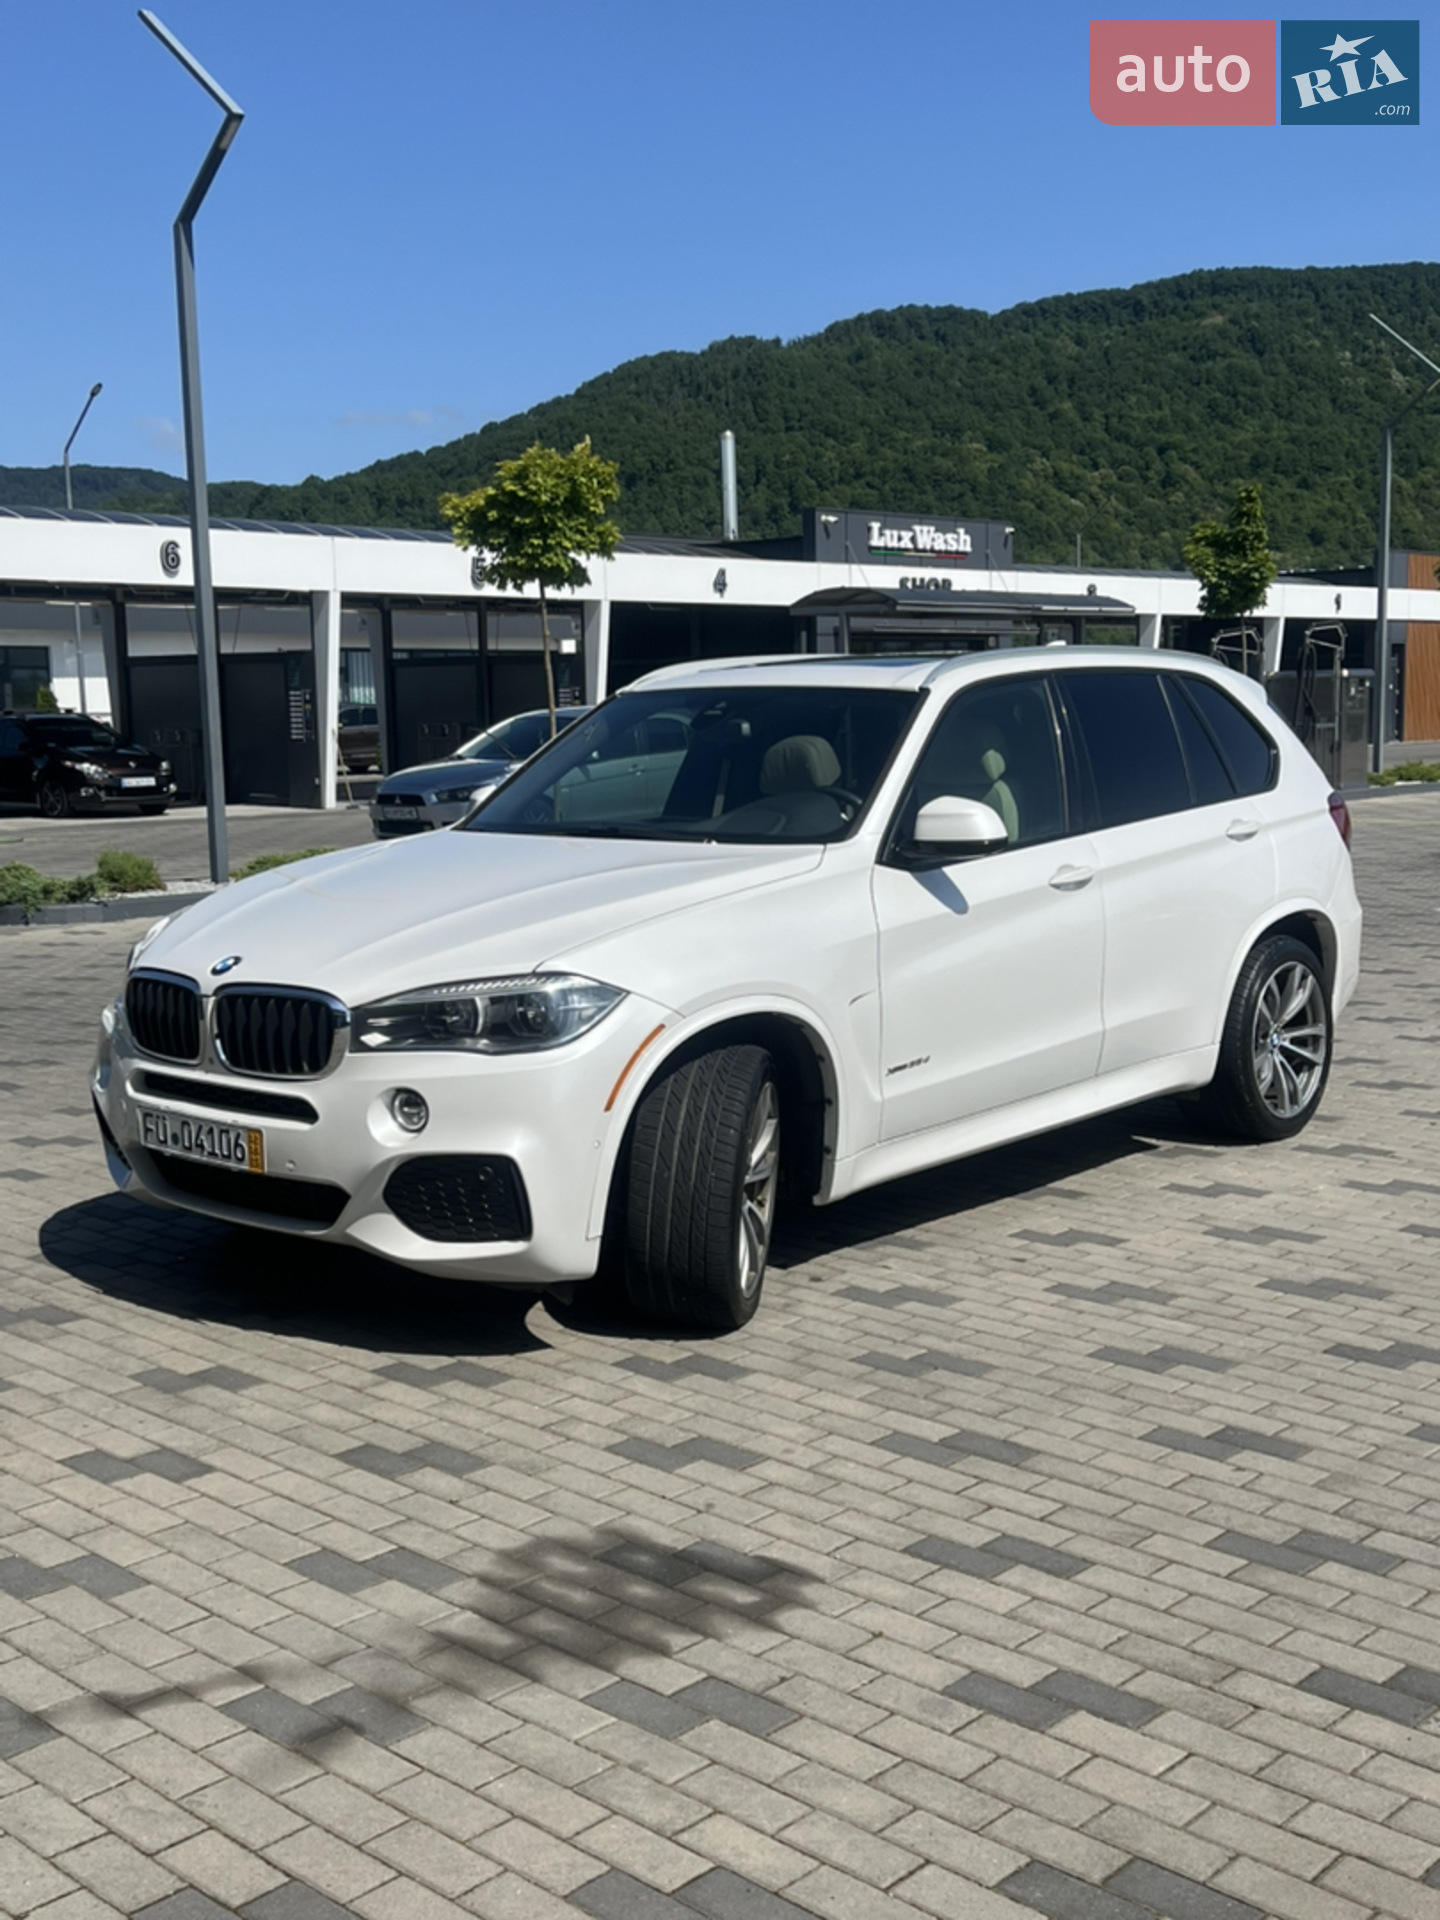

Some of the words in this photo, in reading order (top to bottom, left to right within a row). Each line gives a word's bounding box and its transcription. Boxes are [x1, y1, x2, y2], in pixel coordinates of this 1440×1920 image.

[868, 521, 972, 552] LuxWash
[162, 540, 181, 573] 6
[713, 568, 728, 594] 4
[143, 1112, 168, 1146] FÜ
[181, 1120, 246, 1162] 04106
